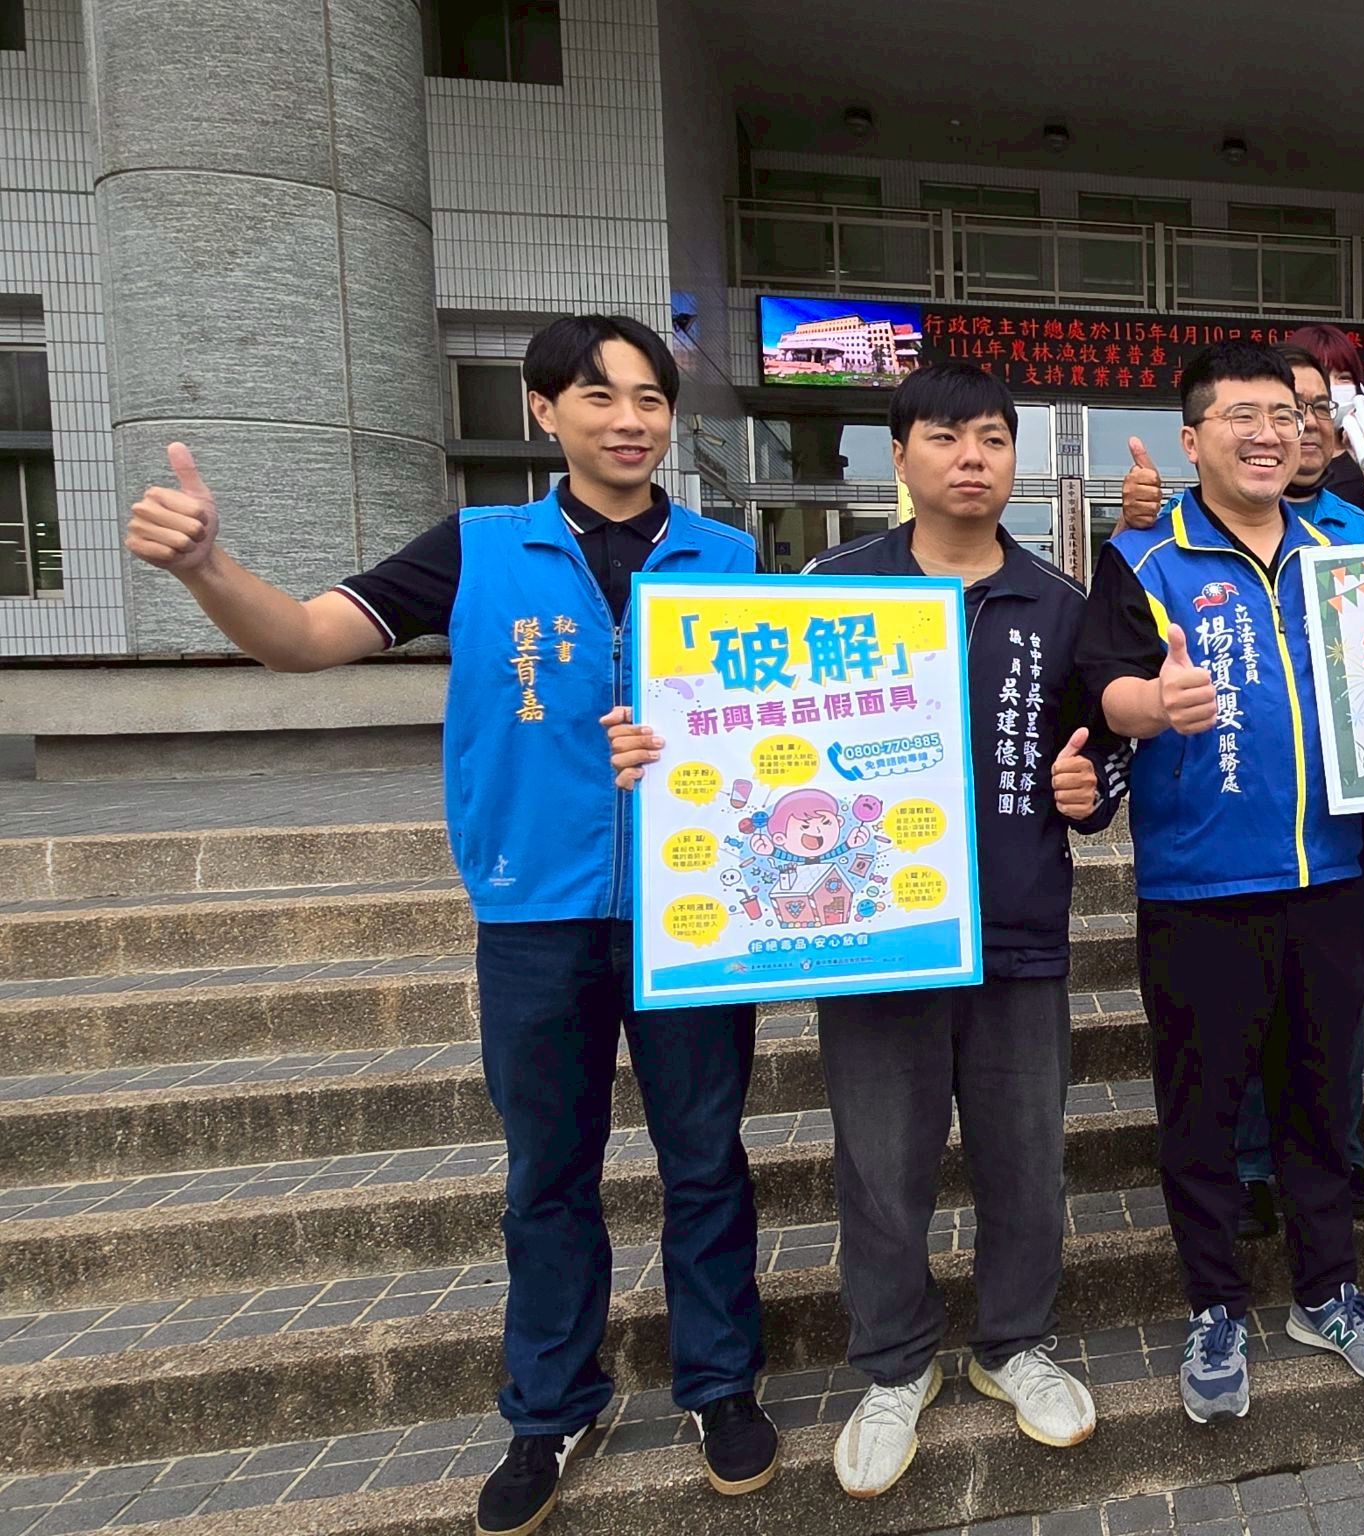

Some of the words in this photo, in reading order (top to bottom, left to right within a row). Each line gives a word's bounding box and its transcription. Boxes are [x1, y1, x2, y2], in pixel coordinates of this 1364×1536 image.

[553, 614, 578, 663] 秘書
[680, 613, 909, 692] 「破解」
[1234, 604, 1261, 685] 立法委員
[687, 684, 918, 736] 新興毒品假面具
[844, 732, 940, 760] 0800-770-885
[750, 938, 807, 953] 拒絕毒品
